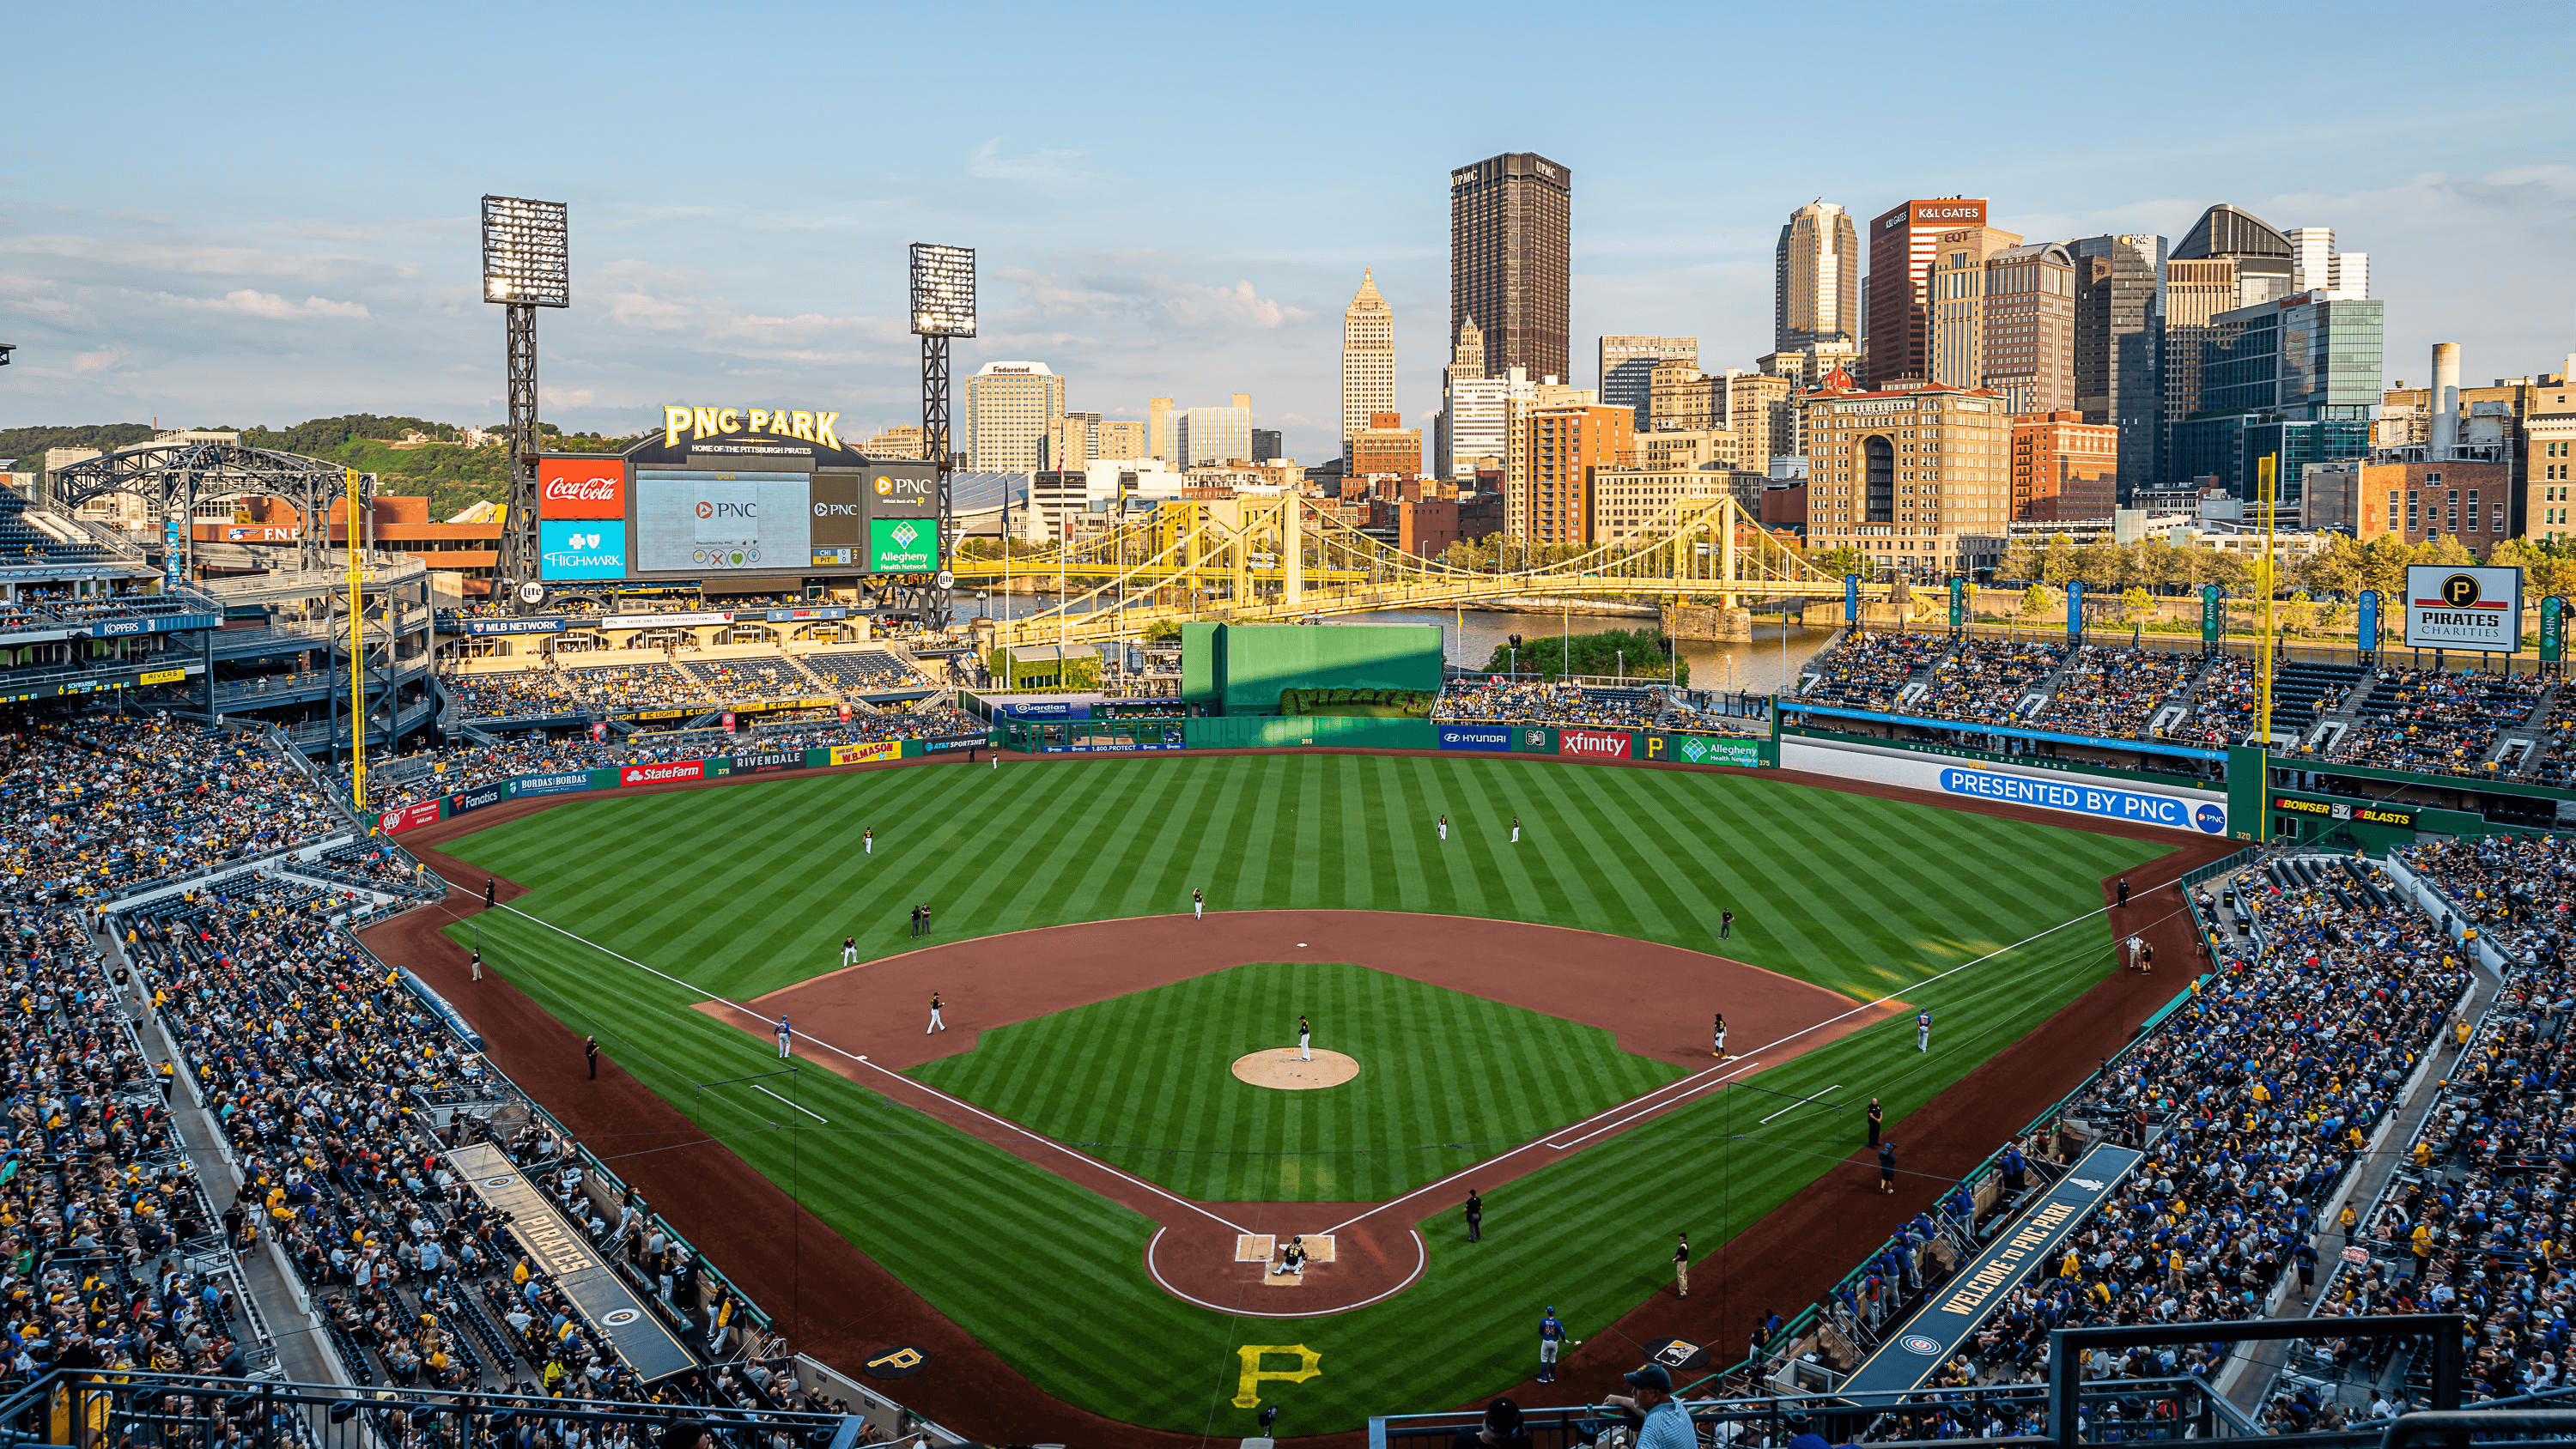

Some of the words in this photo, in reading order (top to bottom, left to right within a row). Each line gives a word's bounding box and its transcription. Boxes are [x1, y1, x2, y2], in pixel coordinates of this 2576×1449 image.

[1536, 161, 1556, 179] UPMC
[1452, 170, 1478, 186] UPMC
[1893, 211, 1907, 225] GATES
[1918, 208, 1940, 218] K&L
[1941, 208, 1978, 218] GATES
[1944, 230, 1971, 243] EQT
[664, 405, 742, 449] PNC
[748, 409, 842, 452] PARK
[691, 445, 714, 453] HOME
[740, 446, 783, 454] PITTSBURGH
[545, 477, 619, 500] Coca-Cola
[895, 479, 933, 494] PNC
[716, 503, 757, 518] PNC
[829, 504, 858, 516] PNC
[547, 553, 623, 567] HIGHMARK
[880, 551, 928, 563] Allegheny
[939, 574, 953, 585] Lite
[523, 586, 541, 598] Lite
[2452, 581, 2470, 602] P
[486, 622, 507, 633] MLB
[509, 621, 558, 632] NETWORK
[2421, 612, 2499, 627] PIRATES
[2545, 616, 2555, 637] AHN
[104, 622, 139, 635] KOPPERS
[2421, 626, 2499, 638] CHARITIES
[148, 670, 178, 679] RIVERS
[58, 685, 64, 695] 6
[1016, 702, 1066, 713] Guardian
[933, 741, 950, 749] AT&T
[950, 738, 987, 748] SPORTSNET
[1462, 734, 1507, 743] HYUNDAI
[1564, 731, 1626, 756] xfinity
[1648, 737, 1663, 758] P
[1710, 743, 1758, 757] Allegheny
[737, 752, 800, 767] RIVENDALE
[1710, 755, 1730, 763] Health
[1909, 744, 1966, 757] WELCOME
[2000, 756, 2023, 765] PNC
[2034, 761, 2068, 771] PARK
[521, 778, 553, 789] BORDAS
[556, 774, 586, 785] BORDAS
[465, 791, 498, 809] Fanatics
[1952, 773, 2076, 807] PRESENTED
[2087, 793, 2117, 812] BY
[2125, 797, 2177, 822] PNC
[416, 815, 433, 824] AAA.com
[2206, 814, 2226, 824] PNC
[2283, 799, 2330, 815] BOWSER
[2362, 809, 2410, 825] BLASTS
[2236, 831, 2251, 840] 320
[2031, 1201, 2076, 1231] PARK
[518, 1215, 593, 1274] PIRATES
[2009, 1226, 2050, 1252] PNC
[2000, 1247, 2026, 1262] TO
[1941, 1258, 2017, 1316] WELCOME
[1230, 1342, 1323, 1409] P
